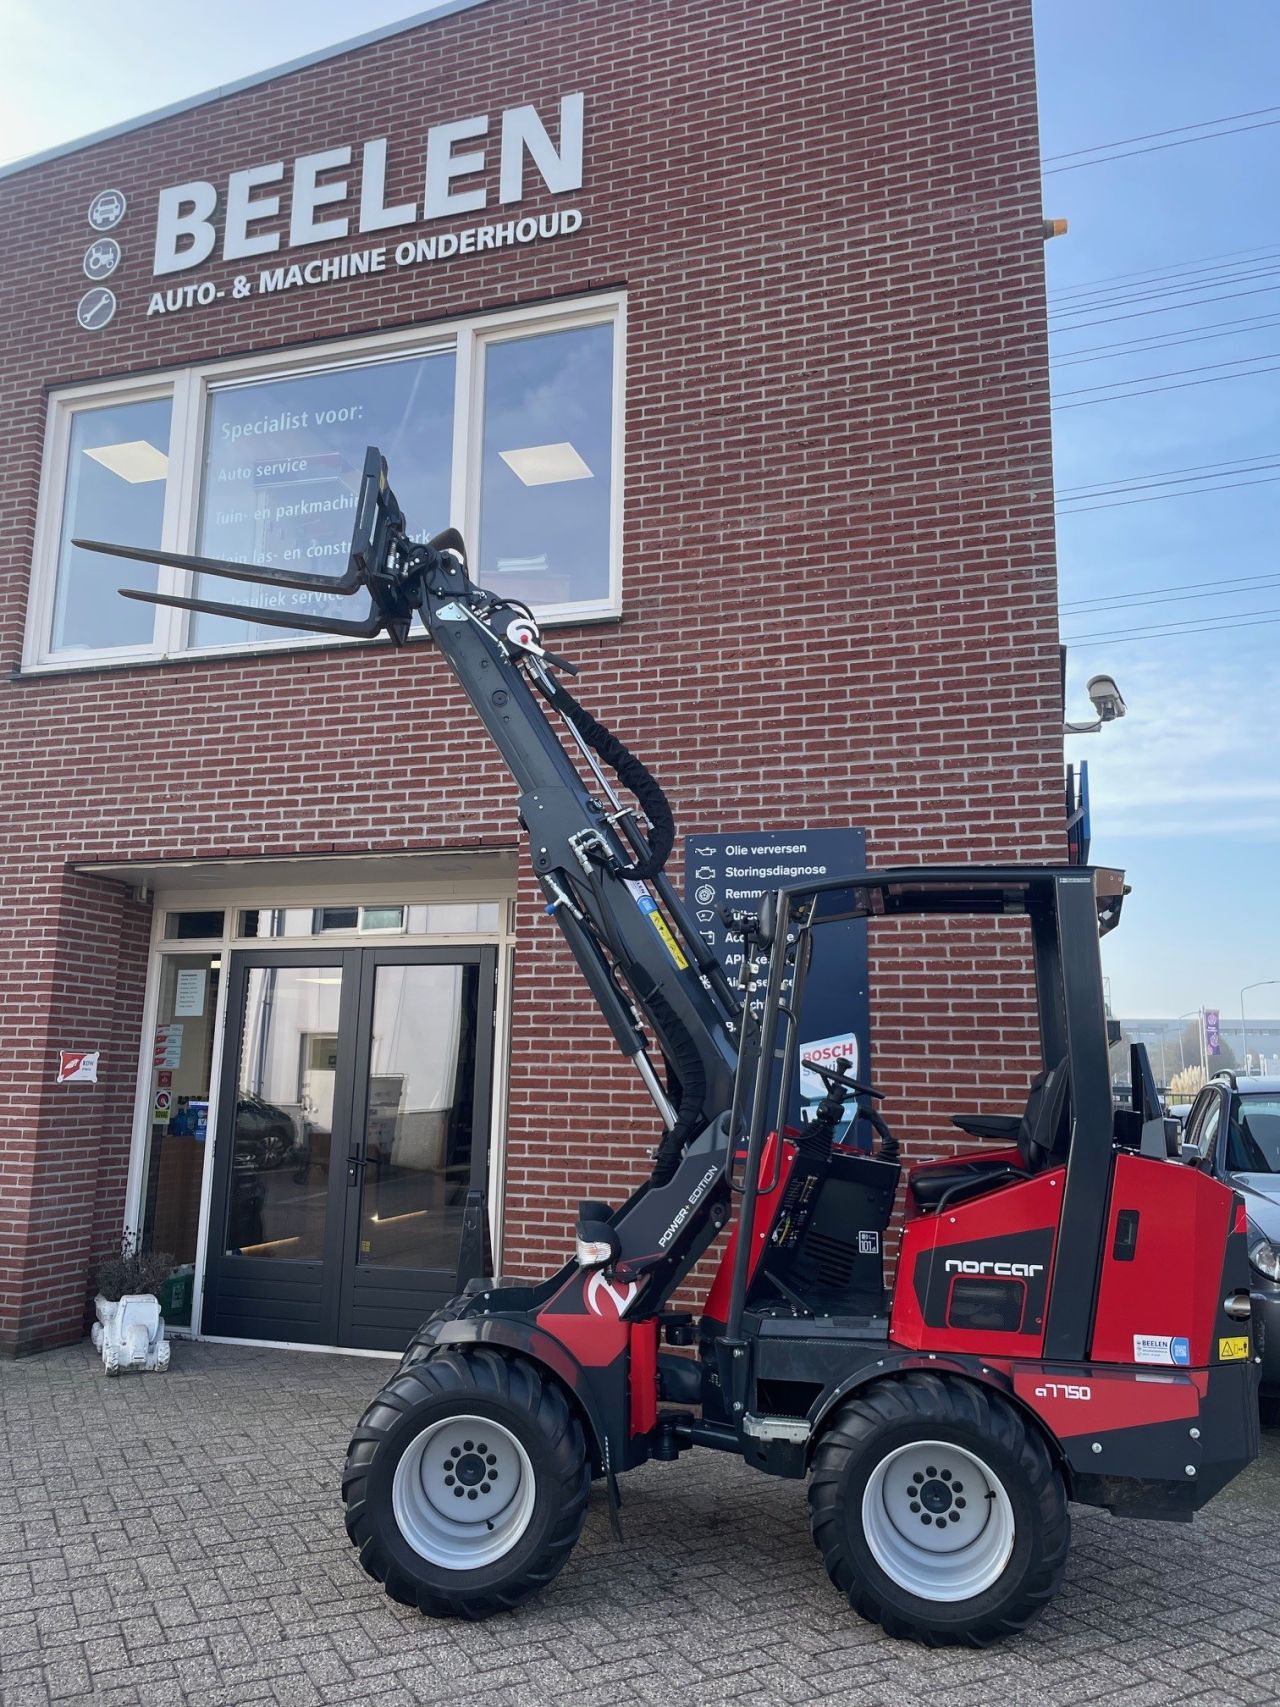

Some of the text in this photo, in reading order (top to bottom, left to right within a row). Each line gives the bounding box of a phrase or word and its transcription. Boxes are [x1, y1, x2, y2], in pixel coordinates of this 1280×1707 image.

[153, 92, 585, 277] BEELEN
[147, 208, 584, 316] AUTO- & MACHINE ONDERHOUD
[221, 404, 364, 443] Specialist voor:
[217, 457, 308, 483] Auto service
[254, 508, 271, 520] en
[284, 548, 301, 560] en
[725, 844, 807, 856] Olie verversen
[725, 865, 827, 879] Storingsdiagnose
[803, 1043, 853, 1062] BOSCH
[688, 1164, 718, 1205] EDITION
[945, 1259, 1044, 1277] norcar
[1141, 1339, 1168, 1348] BEELEN
